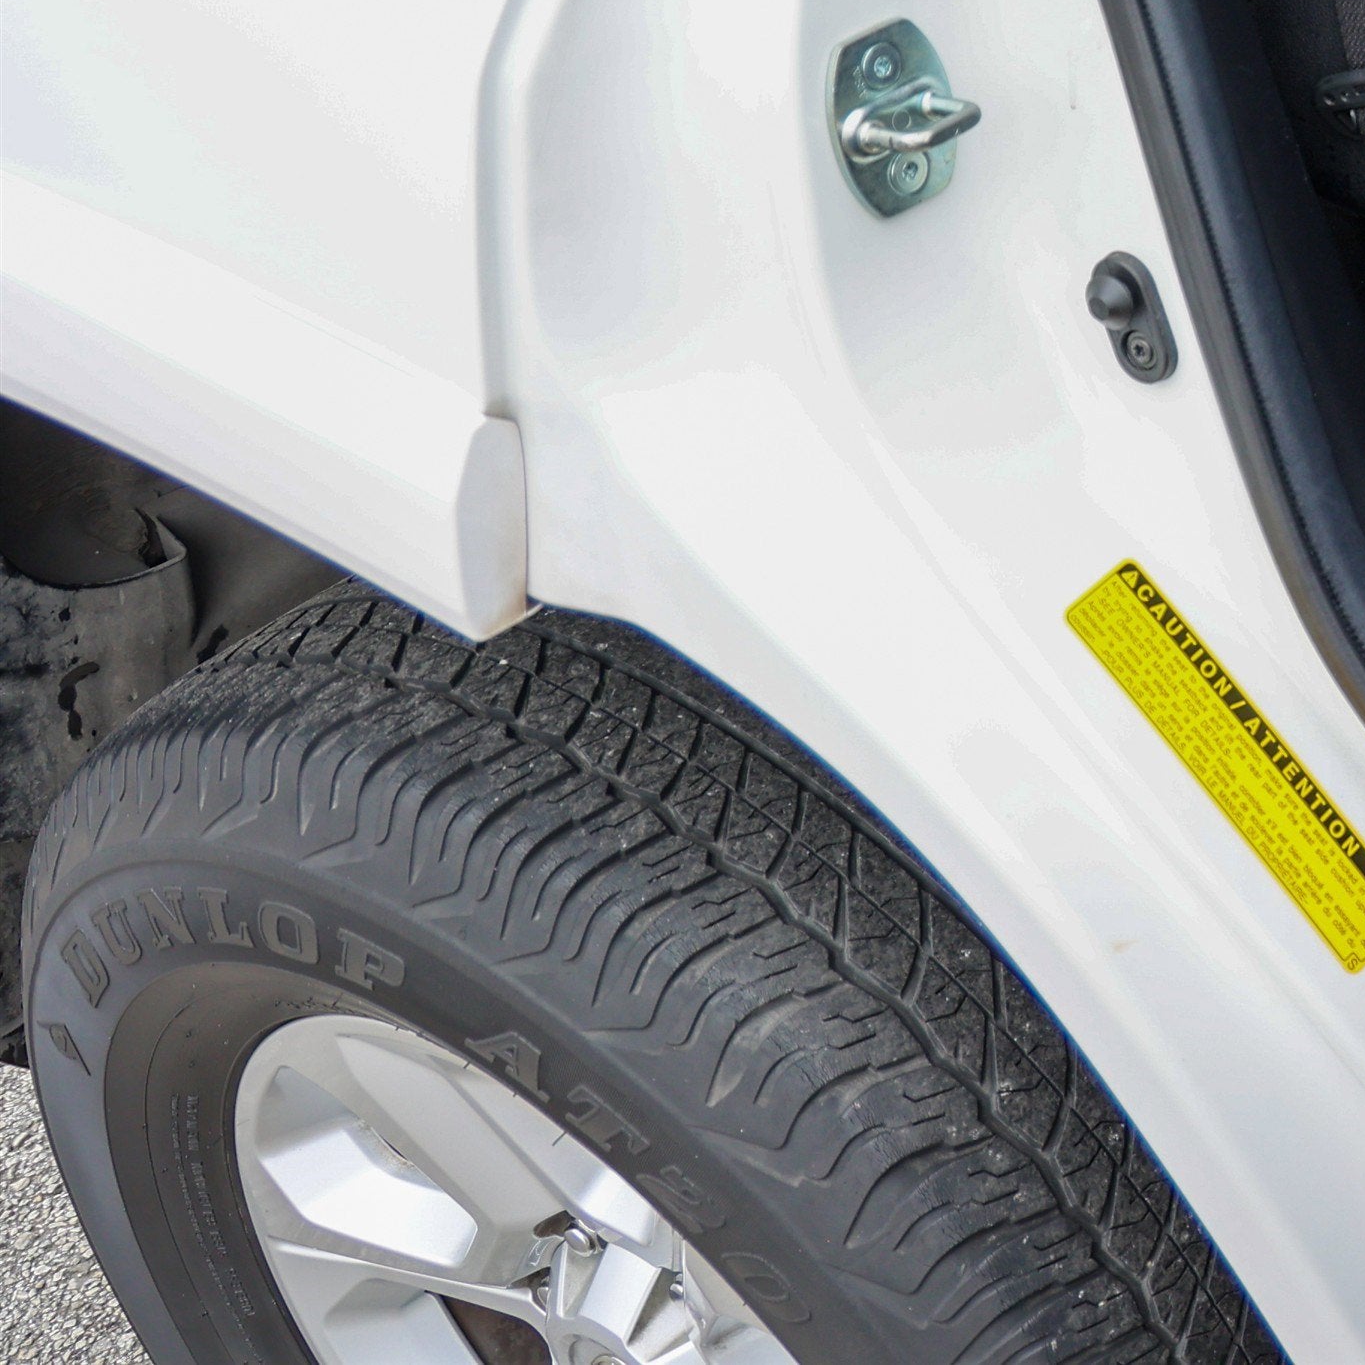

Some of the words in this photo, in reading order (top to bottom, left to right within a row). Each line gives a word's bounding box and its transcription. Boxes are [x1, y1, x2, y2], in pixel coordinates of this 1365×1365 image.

[1134, 581, 1232, 698] CAUTION
[1242, 713, 1361, 858] ATTENTION
[60, 885, 407, 1008] DUNLOP
